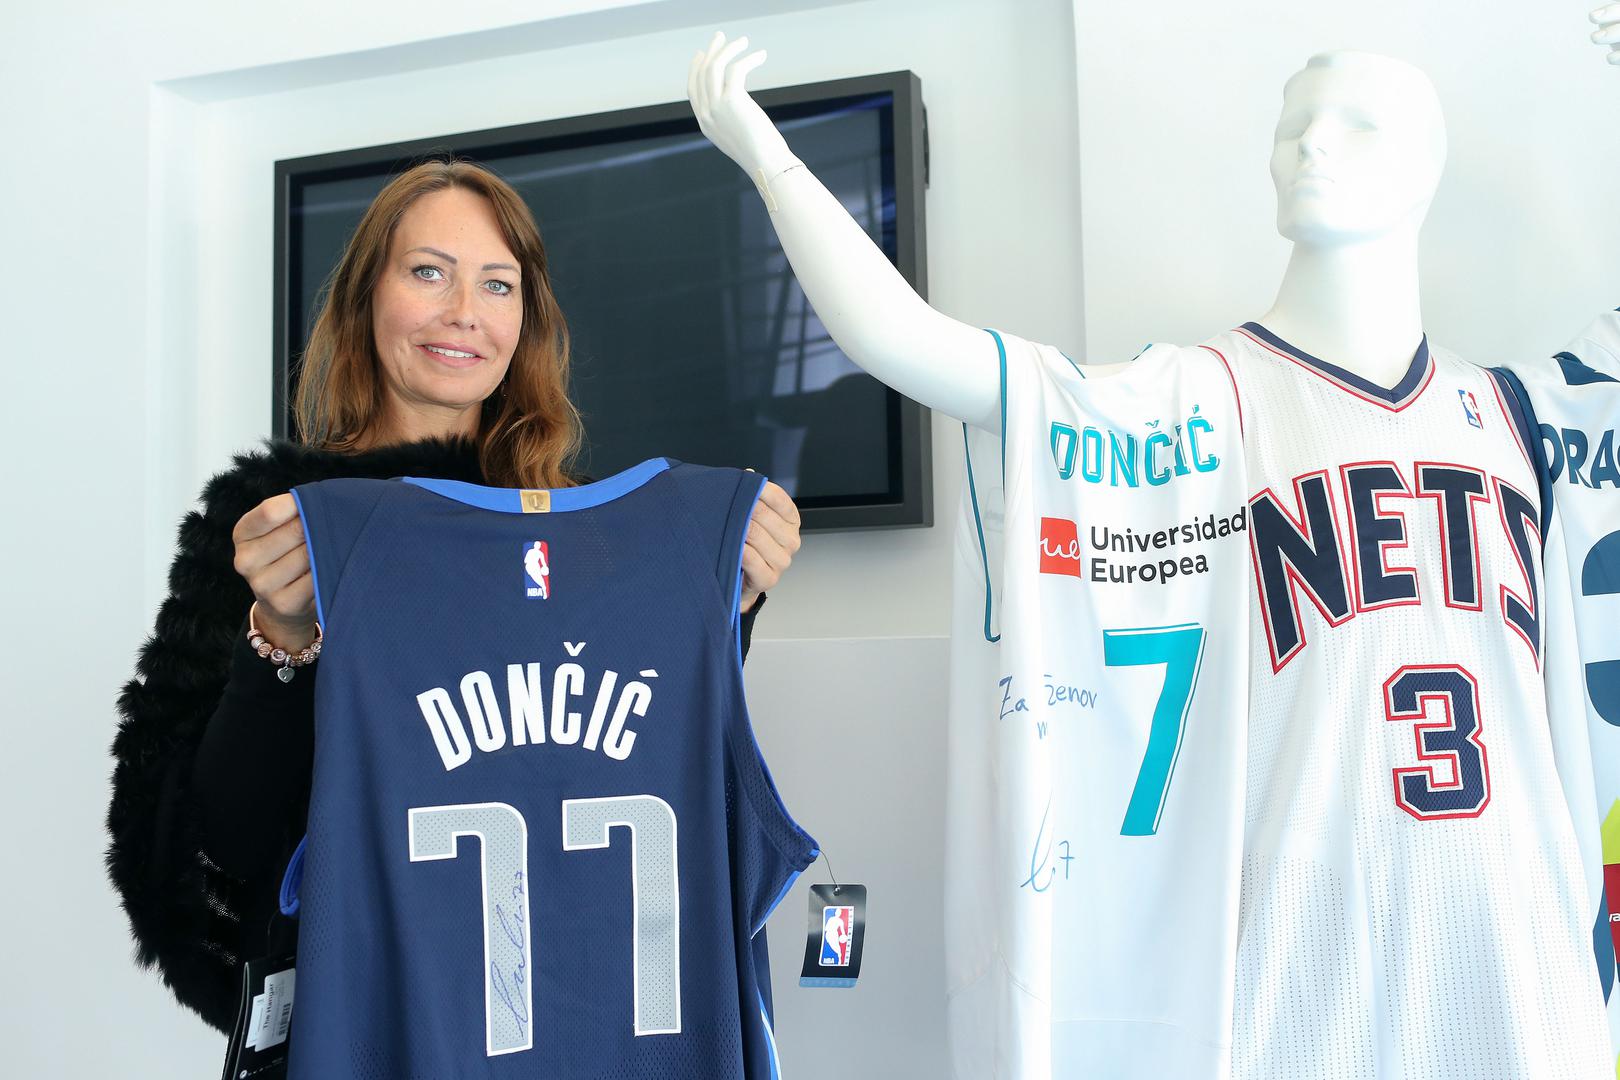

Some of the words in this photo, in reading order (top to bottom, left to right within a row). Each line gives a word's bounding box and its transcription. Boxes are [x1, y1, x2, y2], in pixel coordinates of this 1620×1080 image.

[1049, 404, 1220, 488] DONČIĆ
[1537, 422, 1620, 490] DRA
[1090, 505, 1248, 553] Universidad
[1090, 553, 1210, 585] Europea
[1248, 460, 1544, 676] NETS
[526, 587, 544, 597] NBA
[416, 641, 660, 771] DONČIĆ
[1102, 622, 1207, 837] 7
[1382, 663, 1491, 822] 3
[407, 793, 682, 1057] 77
